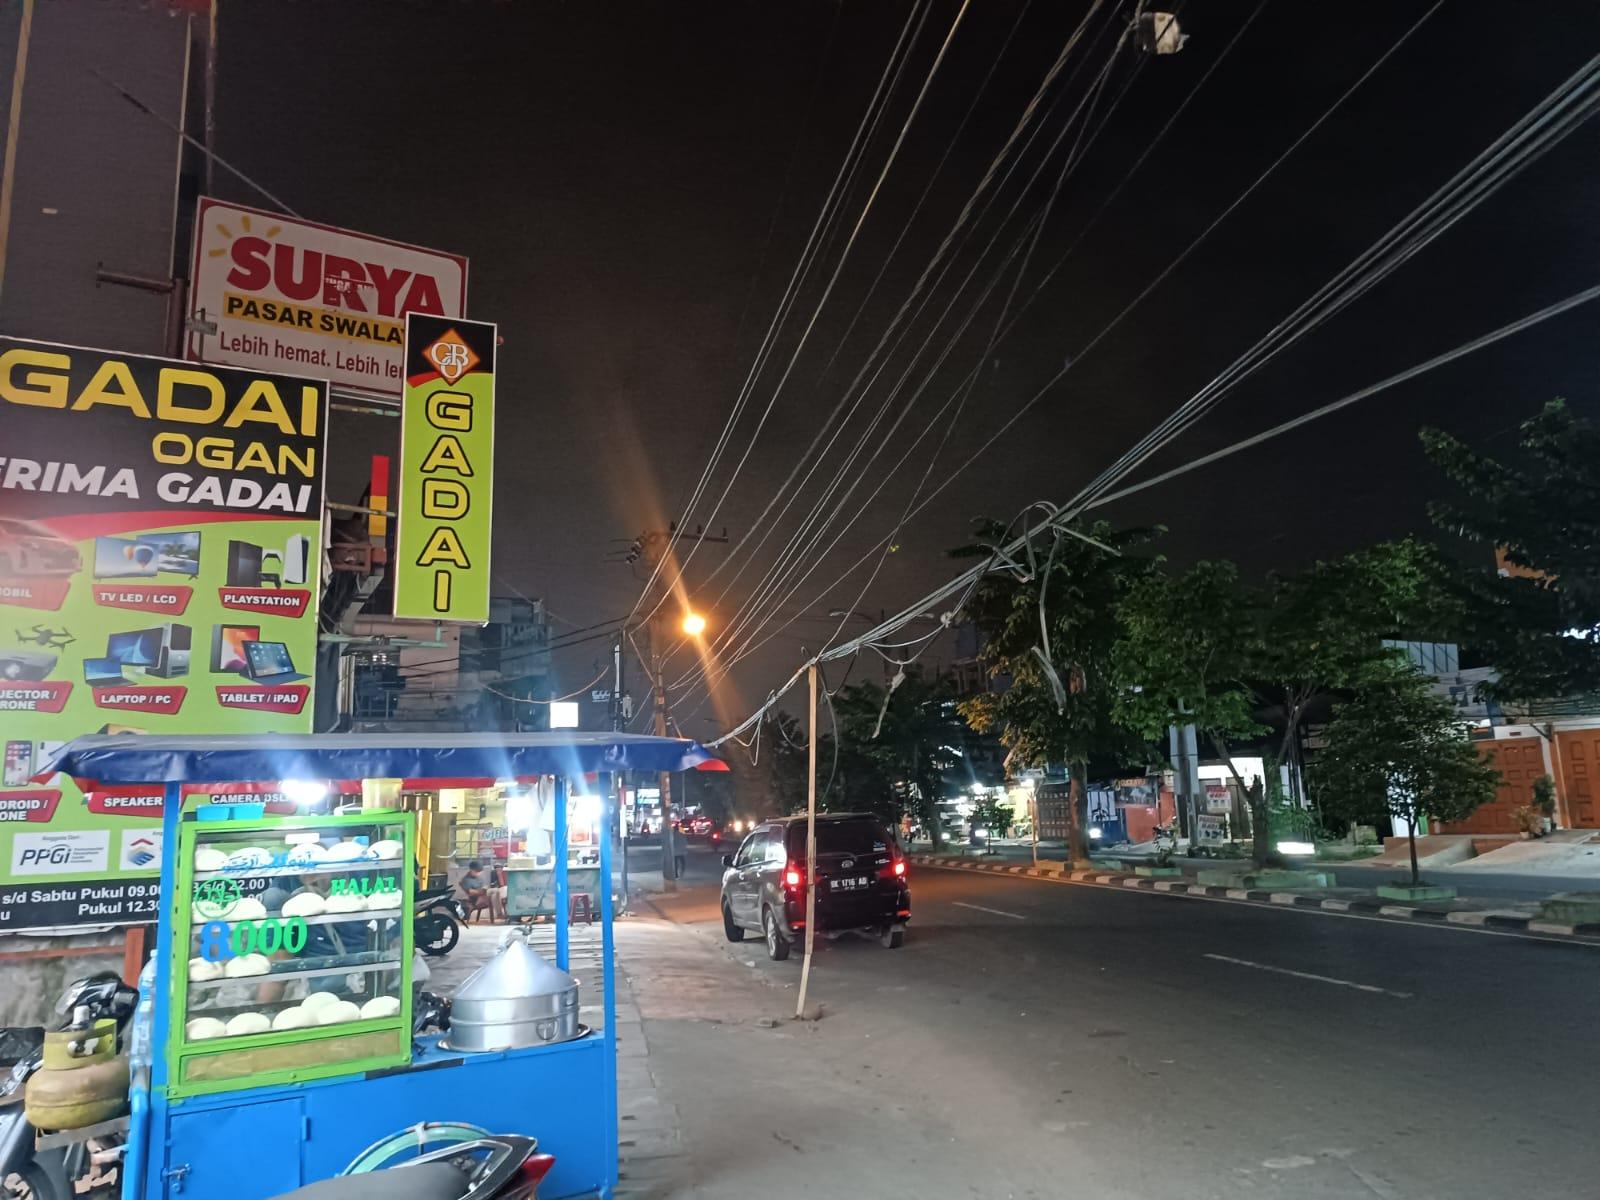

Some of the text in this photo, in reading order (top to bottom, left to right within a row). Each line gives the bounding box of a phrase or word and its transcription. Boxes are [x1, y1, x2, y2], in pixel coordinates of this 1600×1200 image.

[227, 237, 445, 319] SURYA
[228, 297, 313, 329] PASAR
[220, 331, 272, 358] Lebih
[275, 339, 331, 367] hemat.
[336, 351, 379, 377] Lebih
[0, 349, 319, 437] GADAI
[152, 432, 316, 478] OGAN
[156, 472, 313, 513] GADAI
[416, 390, 474, 612] GADAI
[100, 592, 117, 602] TV
[119, 593, 143, 603] LED
[153, 594, 177, 604] LCD
[224, 594, 300, 607] PLAYSTATION
[101, 694, 147, 705] LAPTOP
[155, 694, 171, 705] PC
[220, 693, 265, 704] TABLET
[103, 796, 163, 808] SPEAKER
[211, 794, 260, 805] CAMERA
[2, 892, 27, 904] s/d
[30, 889, 77, 903] Sabtu
[81, 886, 125, 900] Pukul
[78, 901, 122, 916] Pukul
[201, 915, 308, 963] 8000
